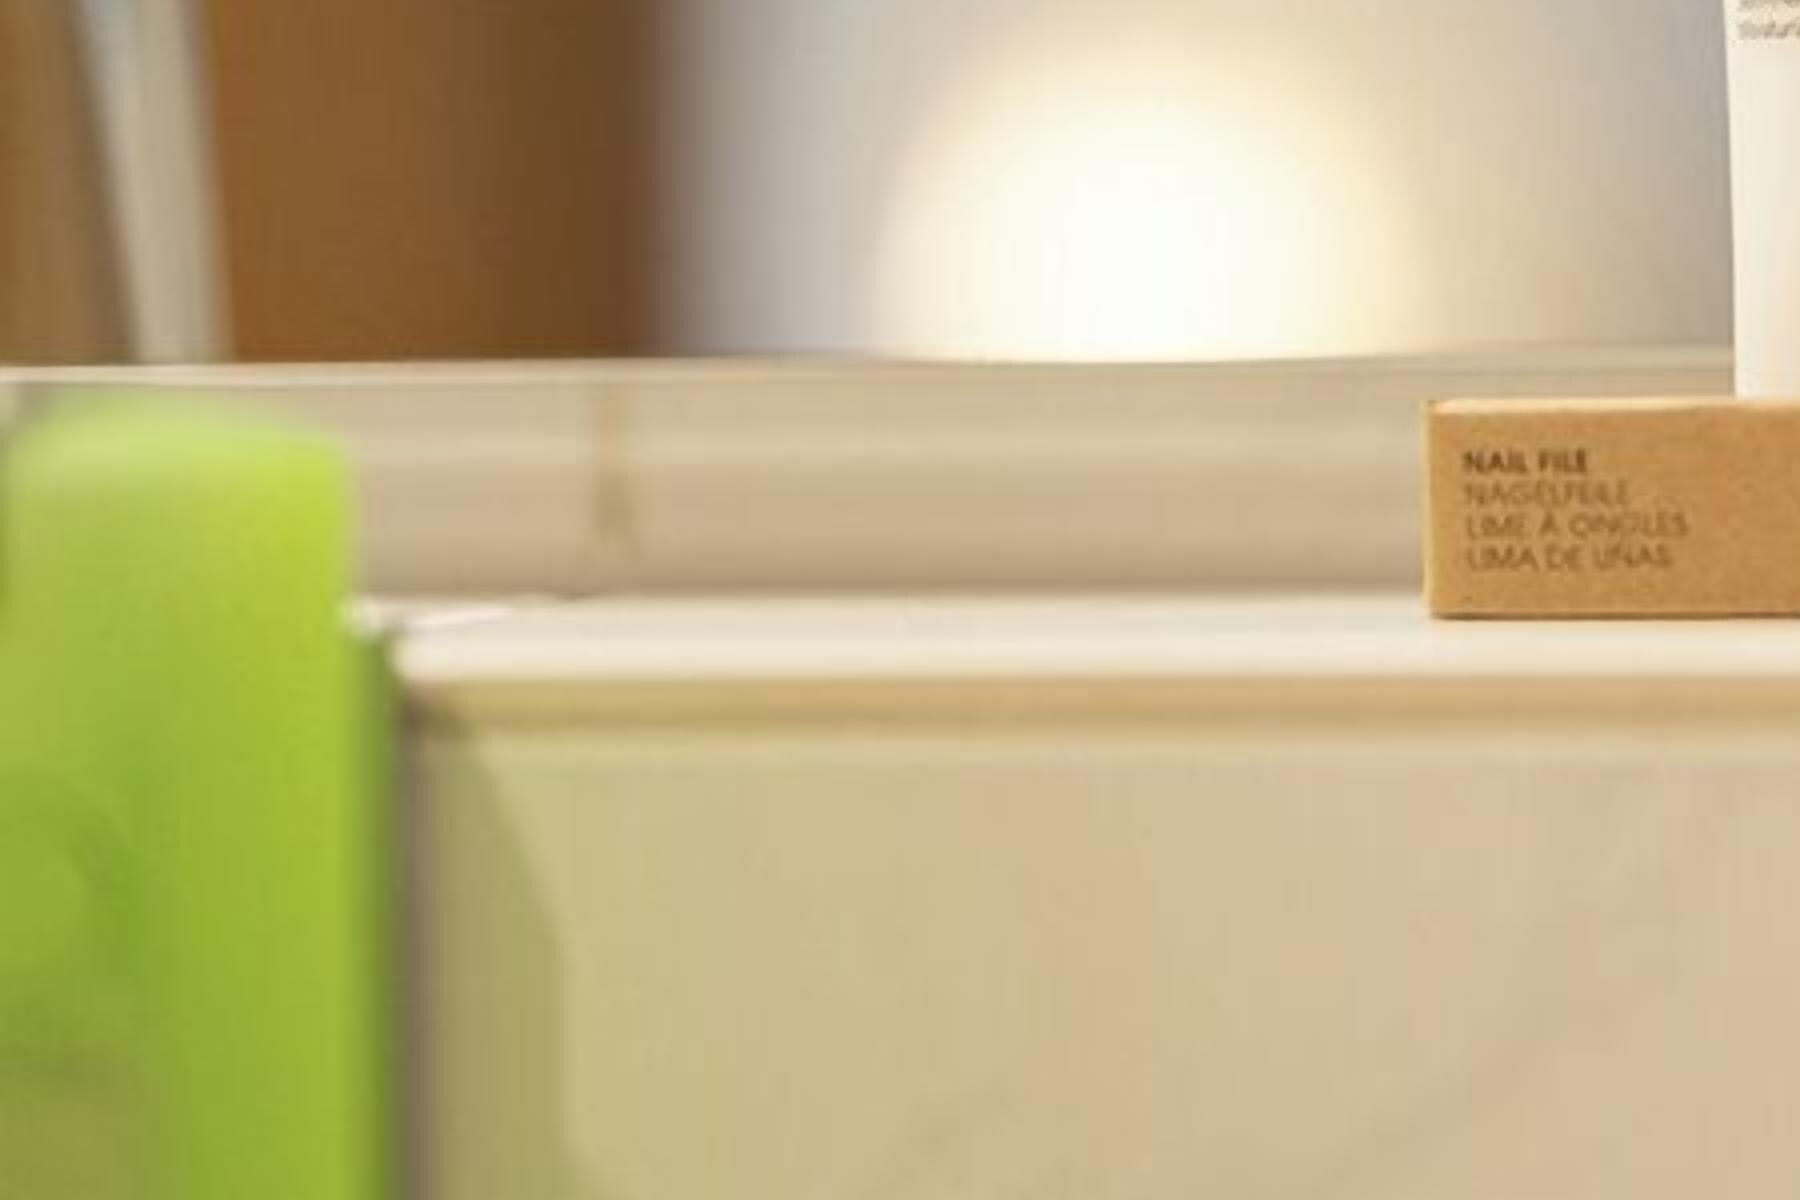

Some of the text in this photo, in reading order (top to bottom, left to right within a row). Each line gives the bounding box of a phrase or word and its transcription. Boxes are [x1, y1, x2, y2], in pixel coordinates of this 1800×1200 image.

[1463, 449, 1586, 474] NAIL FILE
[1466, 513, 1525, 538] LIME
[1467, 547, 1539, 572] LIMA
[1545, 545, 1581, 571] DE
